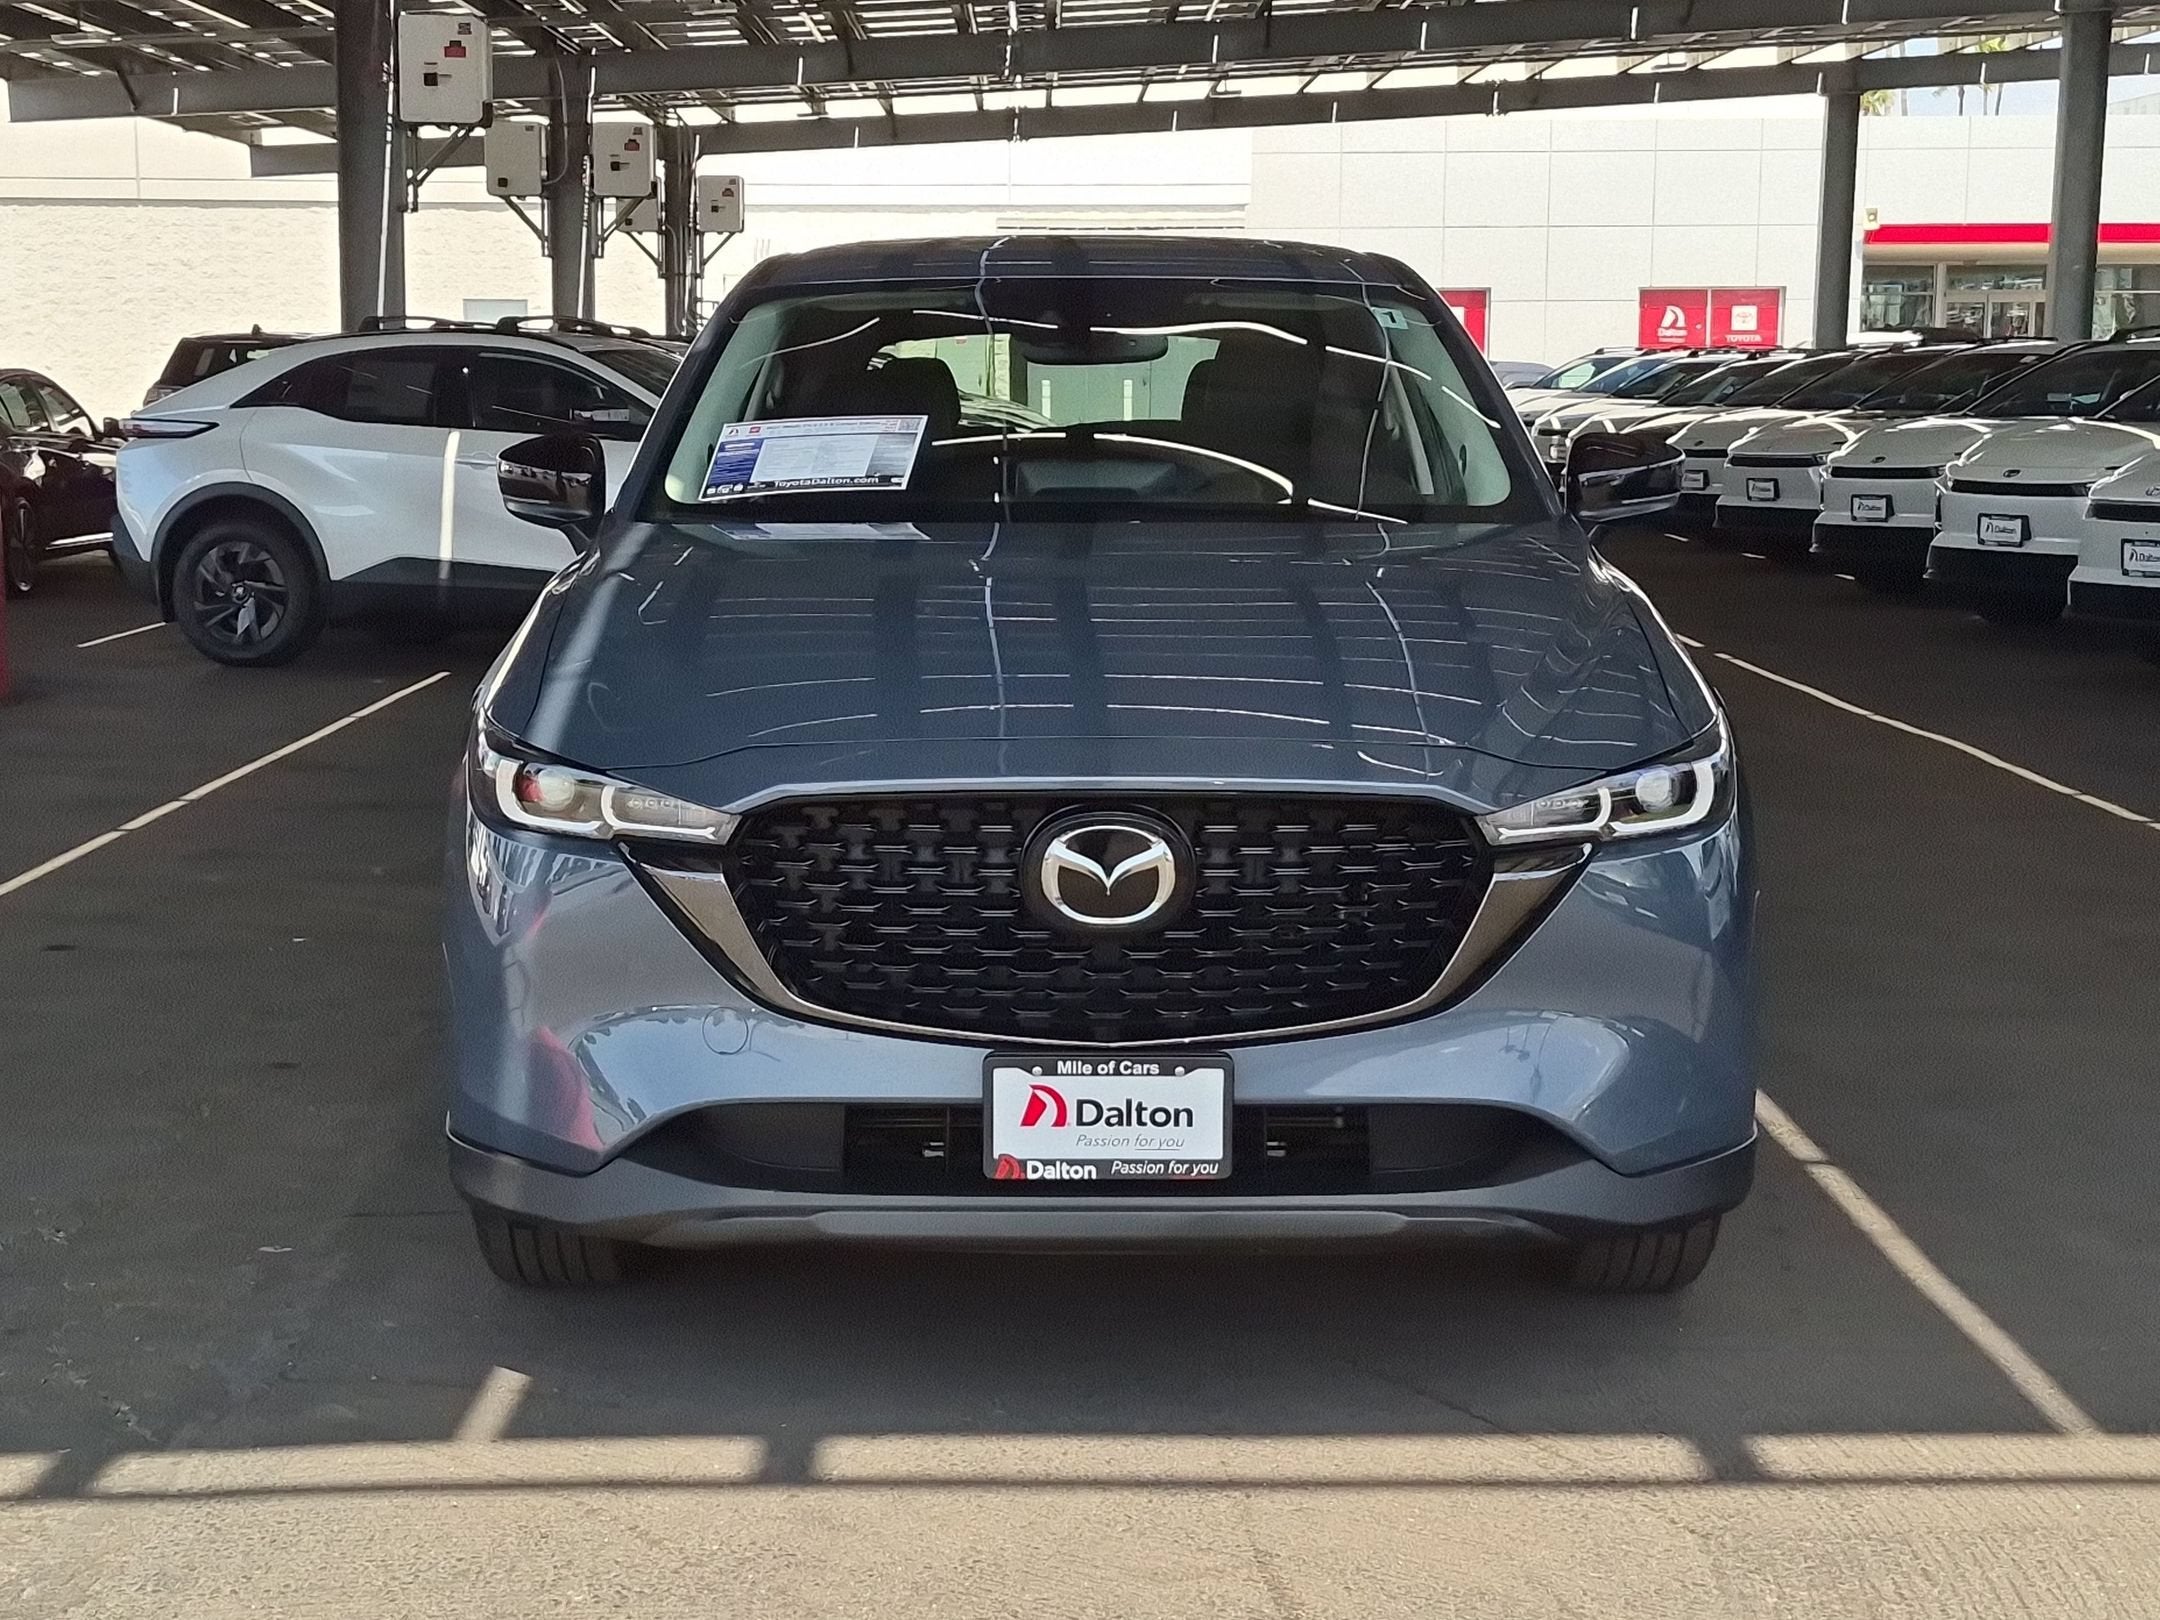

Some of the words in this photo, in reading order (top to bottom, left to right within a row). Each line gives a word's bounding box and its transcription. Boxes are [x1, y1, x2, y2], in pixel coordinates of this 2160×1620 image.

[1725, 334, 1762, 343] TOYOTA
[774, 475, 880, 488] ToyotaDalton.com
[1057, 1060, 1093, 1075] Mile
[1097, 1060, 1117, 1075] of
[1119, 1060, 1160, 1075] Cars
[1076, 1098, 1194, 1128] Dalton
[1075, 1134, 1130, 1147] Passion
[1134, 1133, 1154, 1148] for
[1157, 1138, 1185, 1149] you
[1026, 1160, 1097, 1180] Dalton
[1110, 1160, 1165, 1175] Passion
[1167, 1160, 1190, 1175] for
[1191, 1163, 1219, 1177] you
